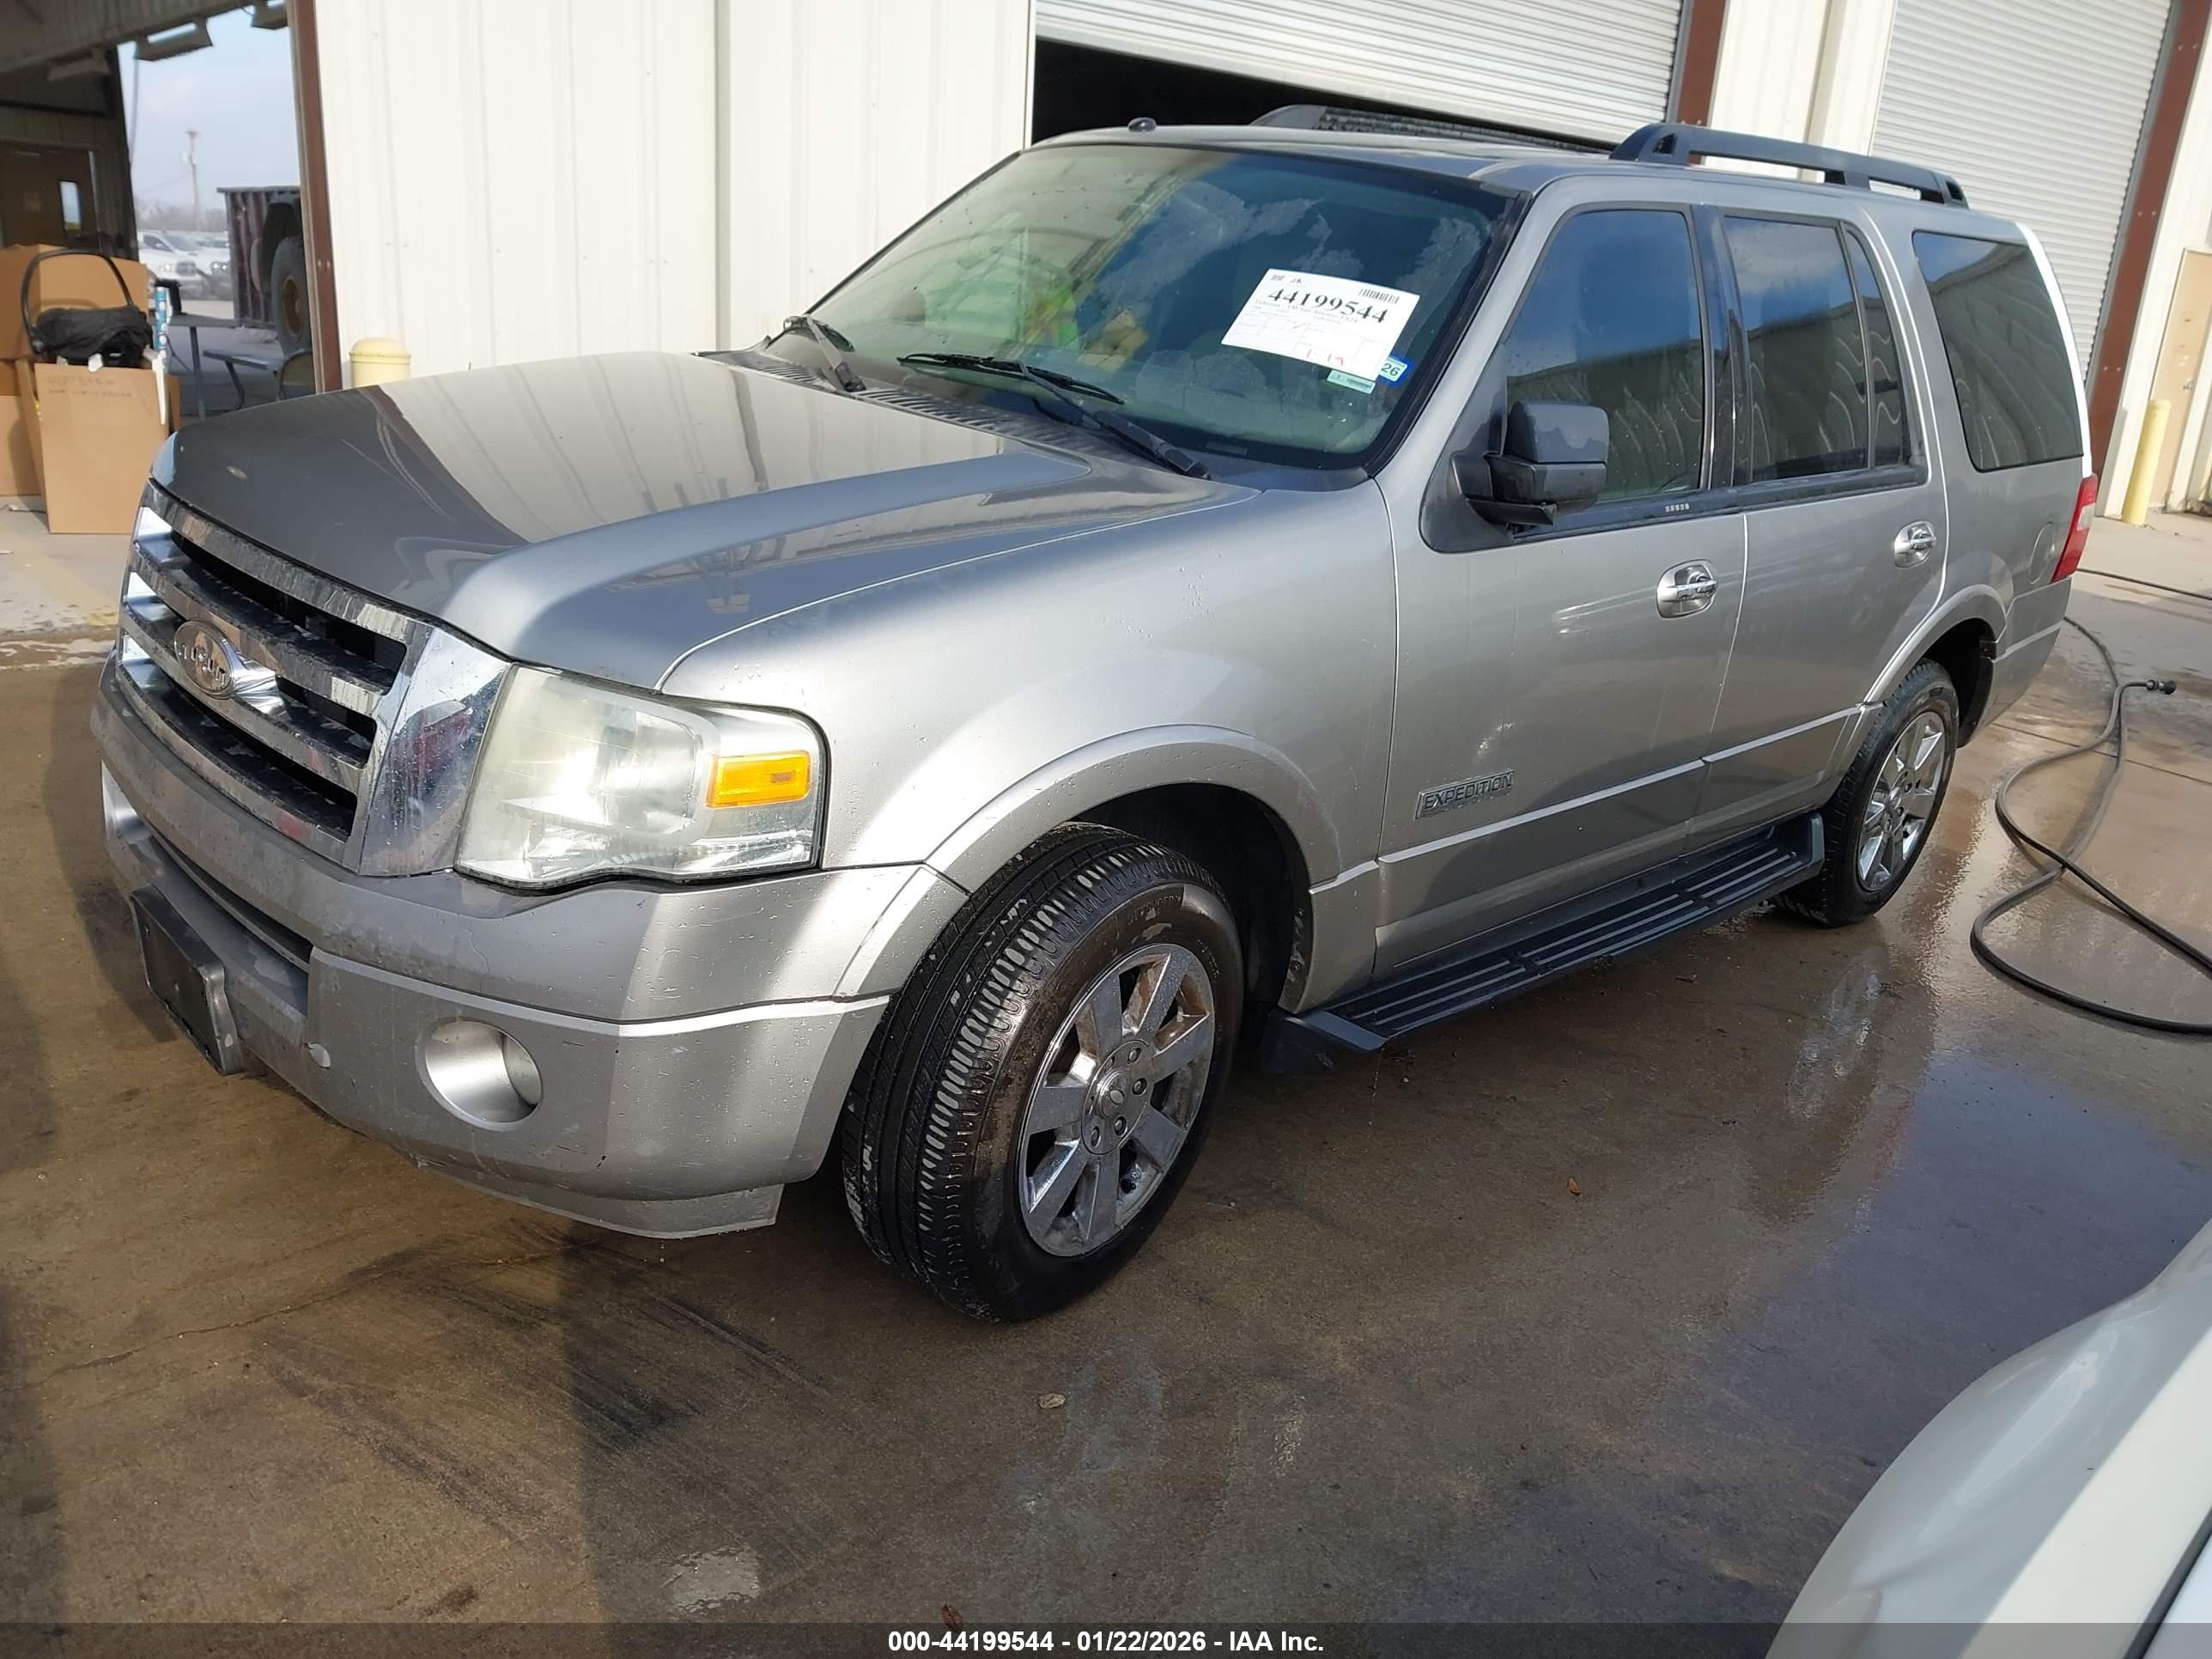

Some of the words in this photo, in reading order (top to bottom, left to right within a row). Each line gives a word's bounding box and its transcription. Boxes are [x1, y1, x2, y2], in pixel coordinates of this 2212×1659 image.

[1268, 288, 1389, 324] 44199544
[1381, 362, 1401, 377] 26
[1424, 772, 1513, 810] EXPEDITION
